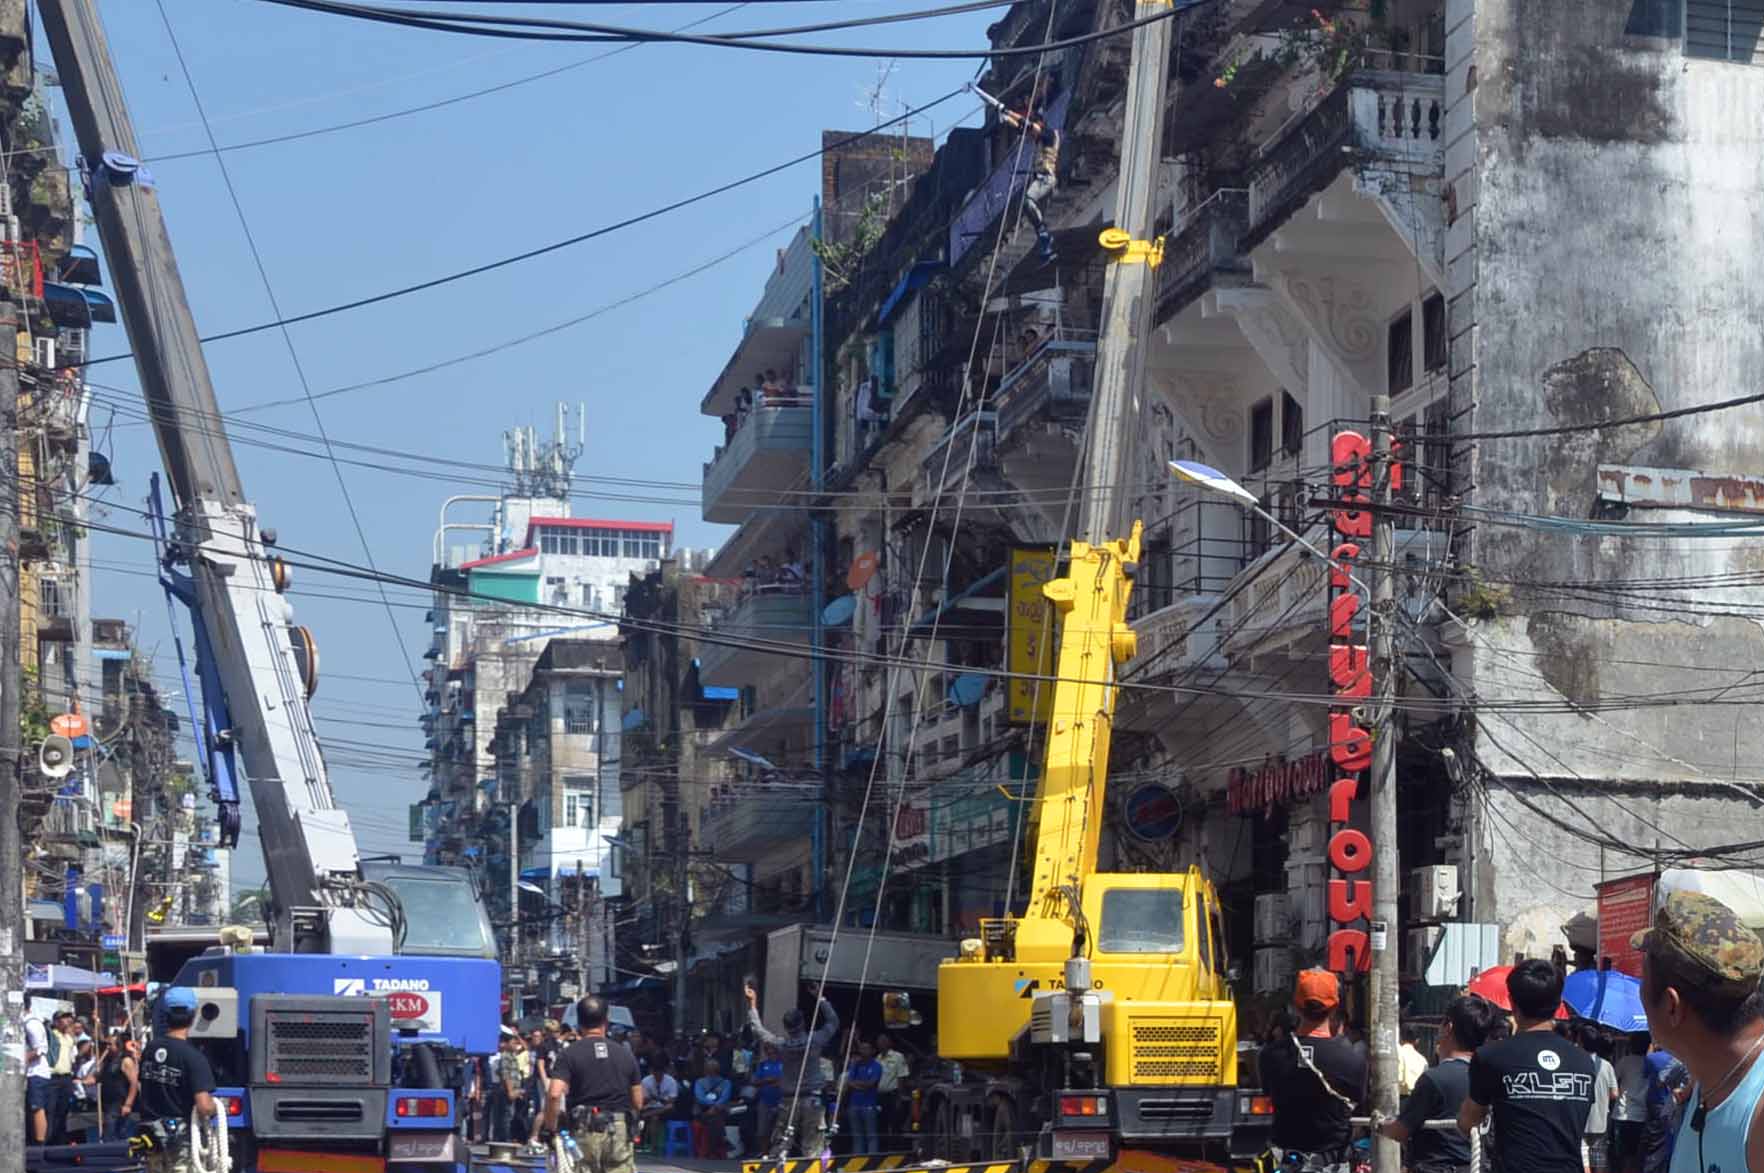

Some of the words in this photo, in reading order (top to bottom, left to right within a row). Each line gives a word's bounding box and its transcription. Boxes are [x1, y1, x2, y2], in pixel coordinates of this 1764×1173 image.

[372, 978, 430, 991] TADANO
[1048, 979, 1104, 990] TAO
[1502, 1072, 1592, 1097] KLST
